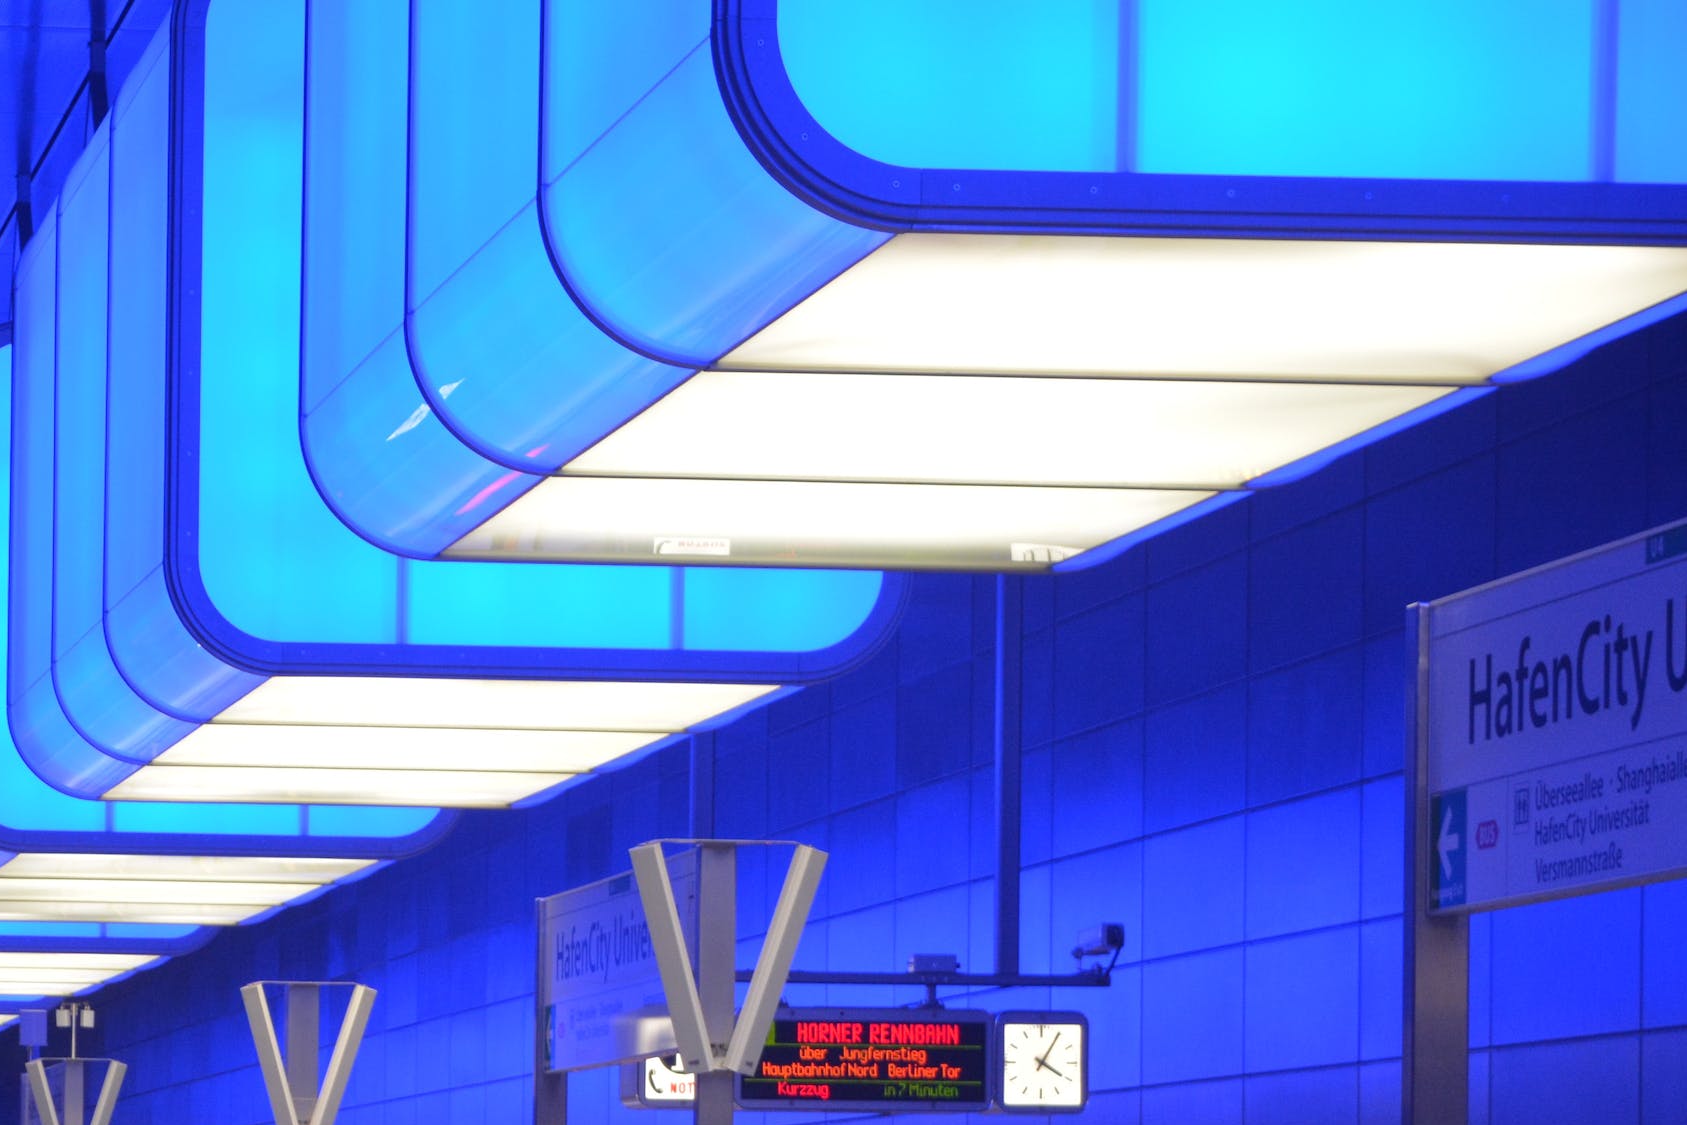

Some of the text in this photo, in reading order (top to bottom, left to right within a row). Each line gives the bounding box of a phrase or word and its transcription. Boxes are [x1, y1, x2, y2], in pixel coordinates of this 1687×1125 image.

[1469, 612, 1653, 745] HafenCity
[1534, 772, 1604, 812] Überseeallee
[1533, 800, 1650, 849] HafenCity Universität
[1535, 841, 1622, 884] Versmannstraße
[555, 919, 613, 985] HafenCity
[797, 1022, 960, 1045] HORNER RENNBAHN
[762, 1061, 961, 1080] Hauptbahnhof Nord Berliner Tor
[799, 1047, 927, 1064] über Jungfernstieg
[670, 1082, 696, 1093] NOT
[777, 1081, 959, 1100] Kurzzug in 7 Minuten
